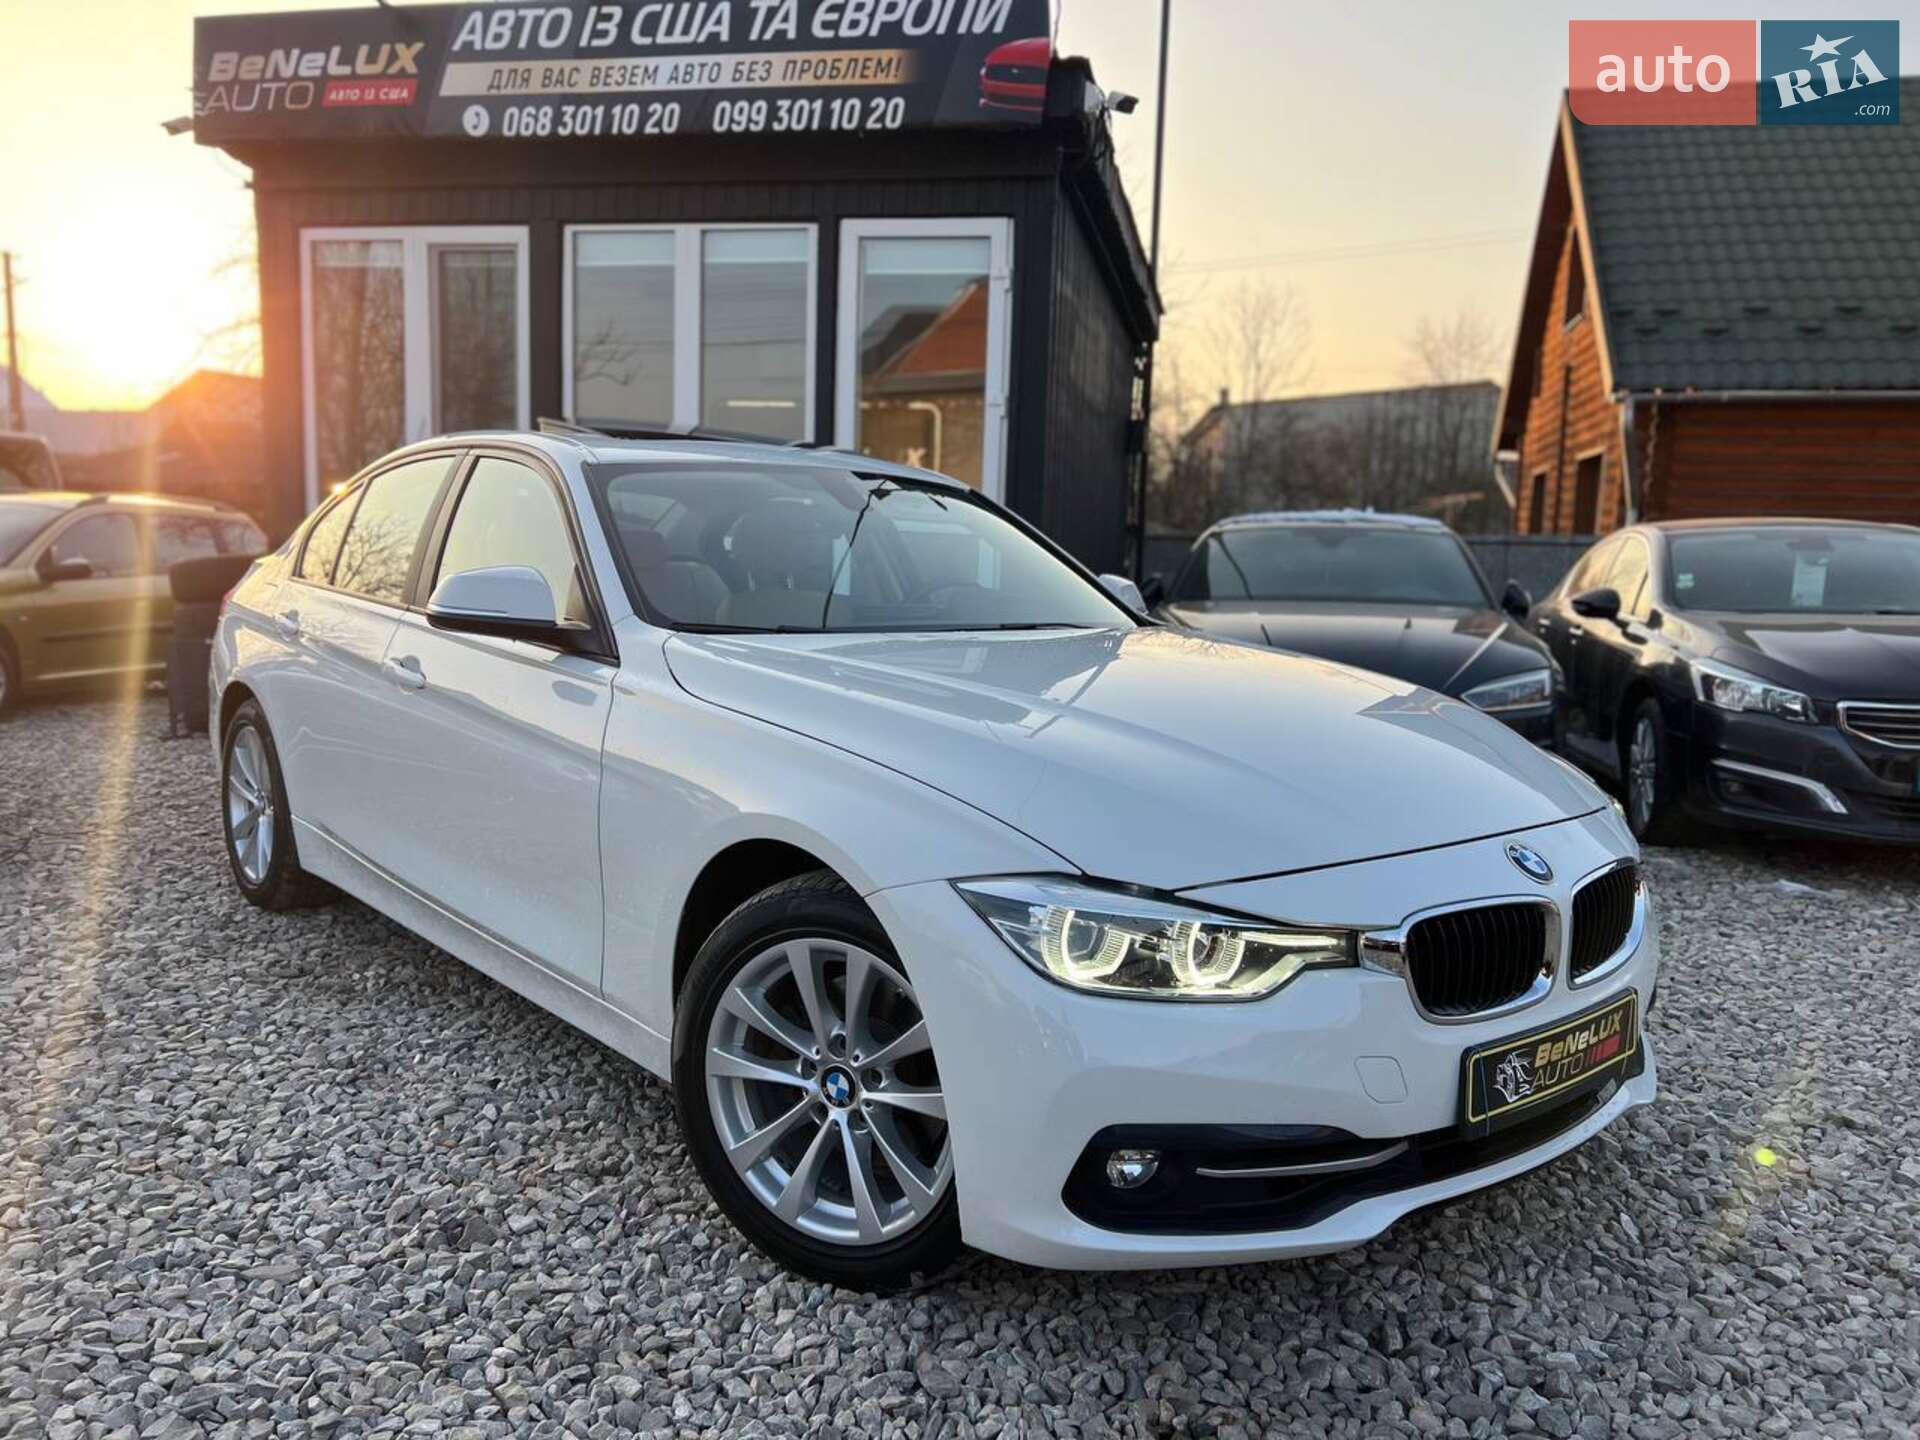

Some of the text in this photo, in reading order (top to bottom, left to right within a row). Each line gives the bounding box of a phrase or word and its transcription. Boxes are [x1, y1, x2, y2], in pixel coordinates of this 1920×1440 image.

[452, 7, 573, 51] АВТО
[630, 1, 731, 45] США
[748, 0, 799, 41] ТА
[811, 0, 1013, 38] ЄВРОПИ
[208, 42, 425, 81] BeNeLUX
[487, 57, 903, 93] ДЛЯ ВАС ВЕЗЕМ АВТО БЕЗ ПРОБЛЕМ!
[203, 81, 314, 112] AUTO
[712, 97, 905, 132] 099 301 10 20
[502, 102, 681, 137] 068 301 10 20
[1532, 1052, 1584, 1089] AUTO
